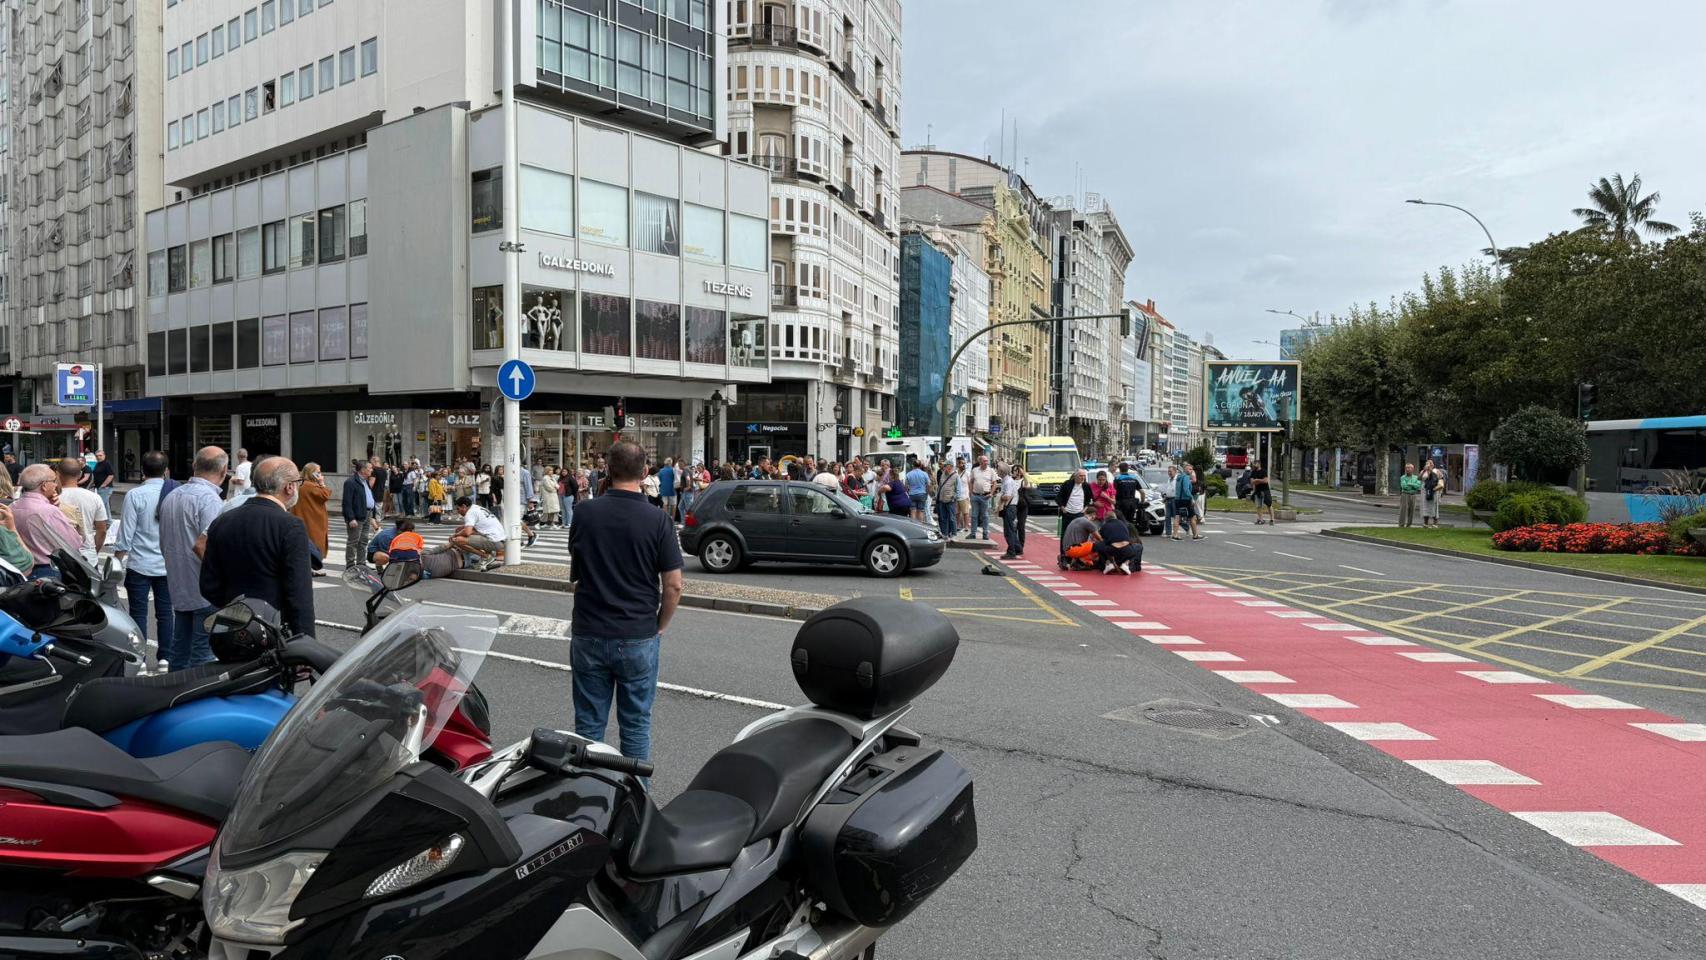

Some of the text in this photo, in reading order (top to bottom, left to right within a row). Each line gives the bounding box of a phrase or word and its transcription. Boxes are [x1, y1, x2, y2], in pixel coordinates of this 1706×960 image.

[541, 254, 616, 277] CALZEDONIA
[704, 280, 753, 298] TEZENIS
[66, 375, 86, 395] P
[1215, 366, 1288, 388] ANUEL AA
[246, 418, 278, 427] CALZEDONIA
[354, 414, 395, 424] CALZEDONIA
[762, 424, 788, 433] Negocios
